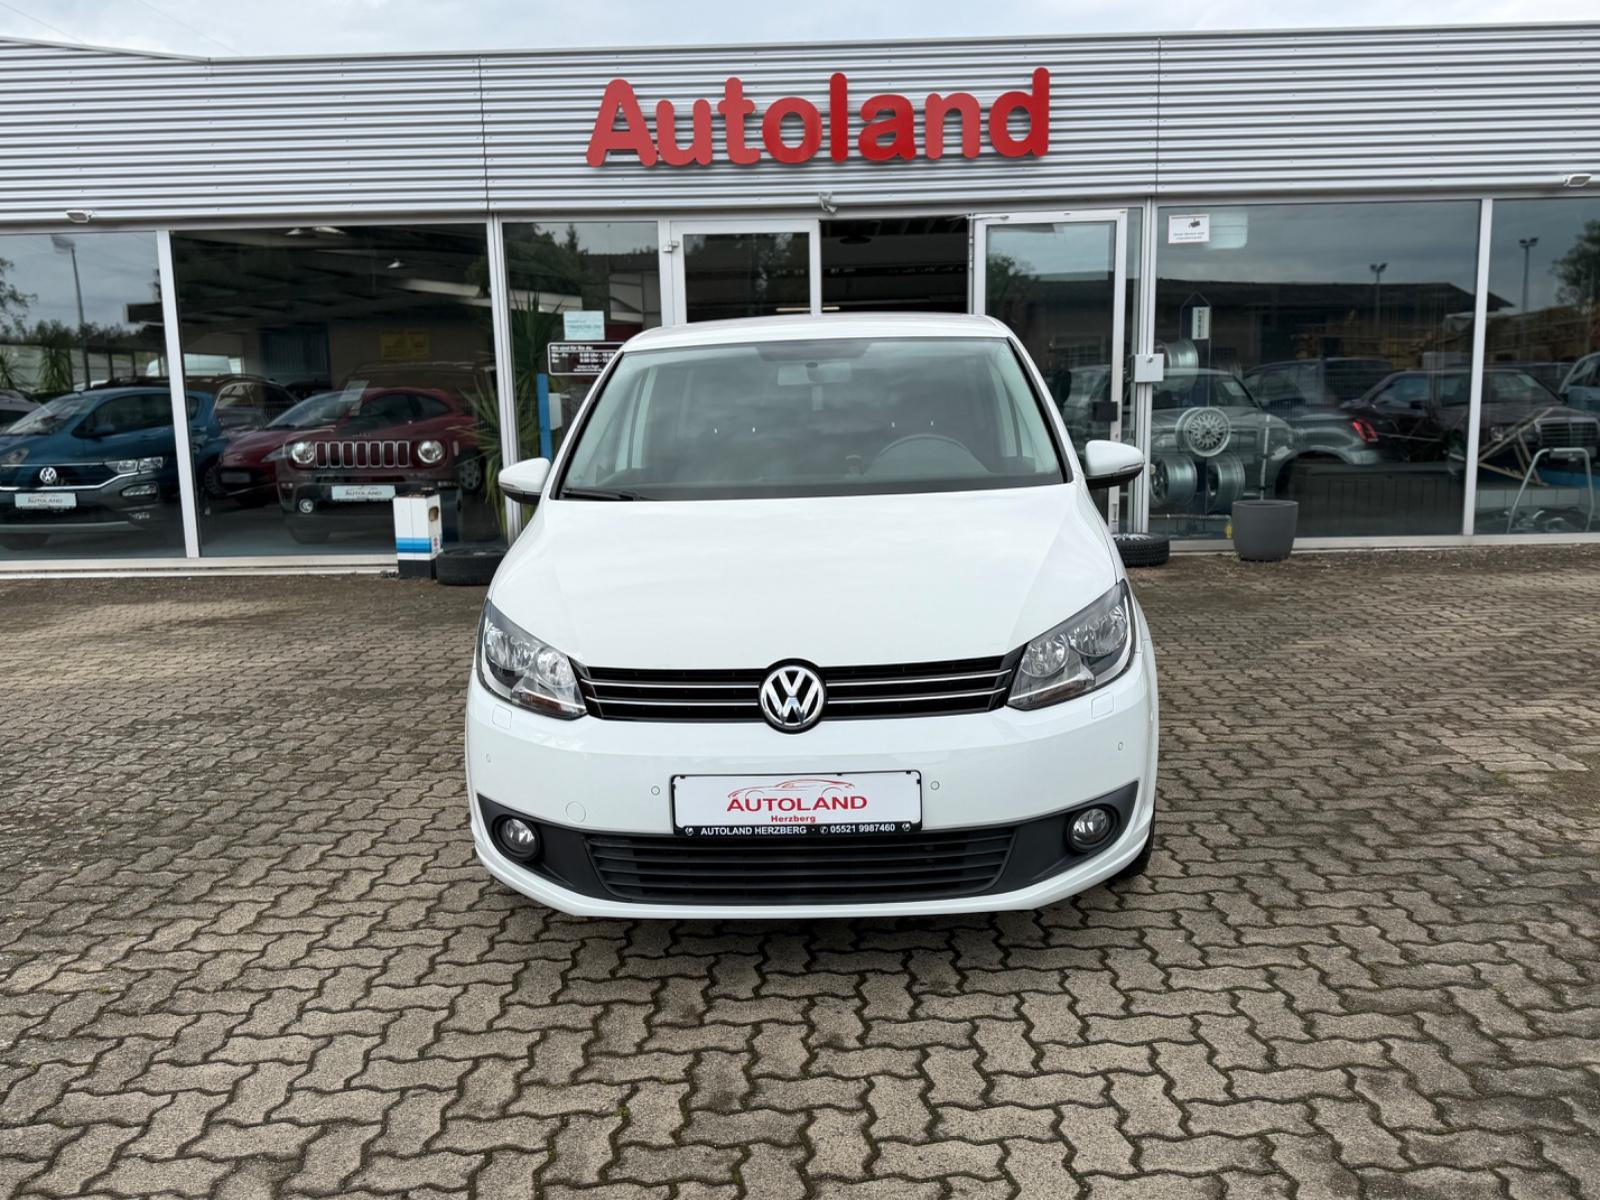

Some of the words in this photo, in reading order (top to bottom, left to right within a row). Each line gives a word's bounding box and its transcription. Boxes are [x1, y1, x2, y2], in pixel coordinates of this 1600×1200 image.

[586, 67, 1050, 167] Autoland
[761, 666, 824, 729] VW
[726, 795, 868, 812] AUTOLAND
[771, 814, 817, 824] Herzberg
[700, 826, 753, 836] AUTOLAND
[754, 825, 807, 835] HERZBERG
[830, 824, 856, 833] 05521
[858, 823, 896, 832] 9987460
